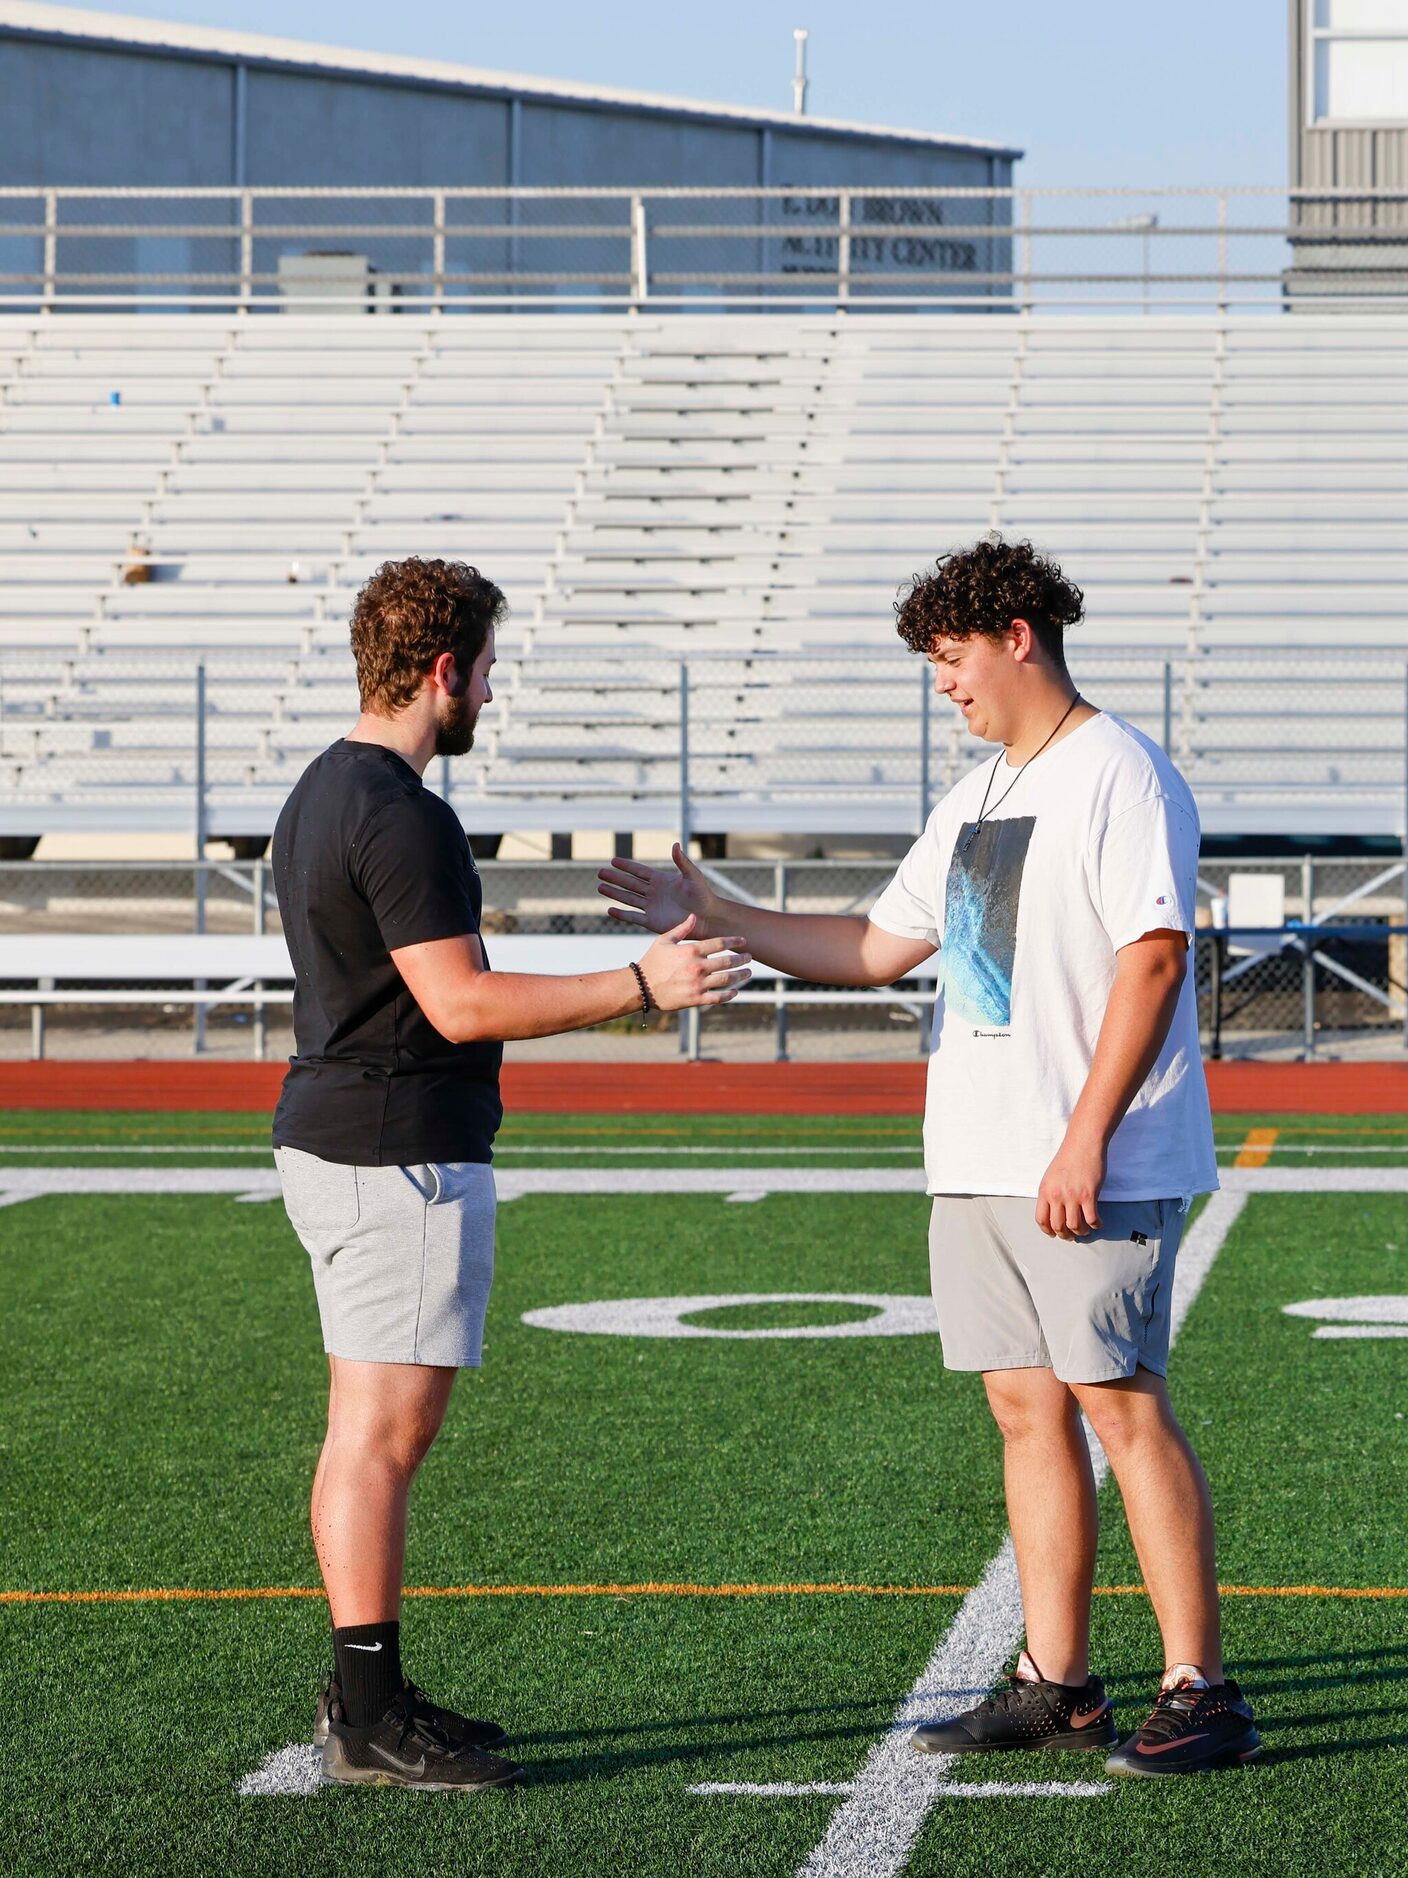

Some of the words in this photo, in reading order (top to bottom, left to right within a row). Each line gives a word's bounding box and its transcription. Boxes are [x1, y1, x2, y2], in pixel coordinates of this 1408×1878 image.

[782, 230, 885, 262] ACTIITY
[891, 236, 977, 271] CENTER
[972, 1029, 1011, 1040] Champion
